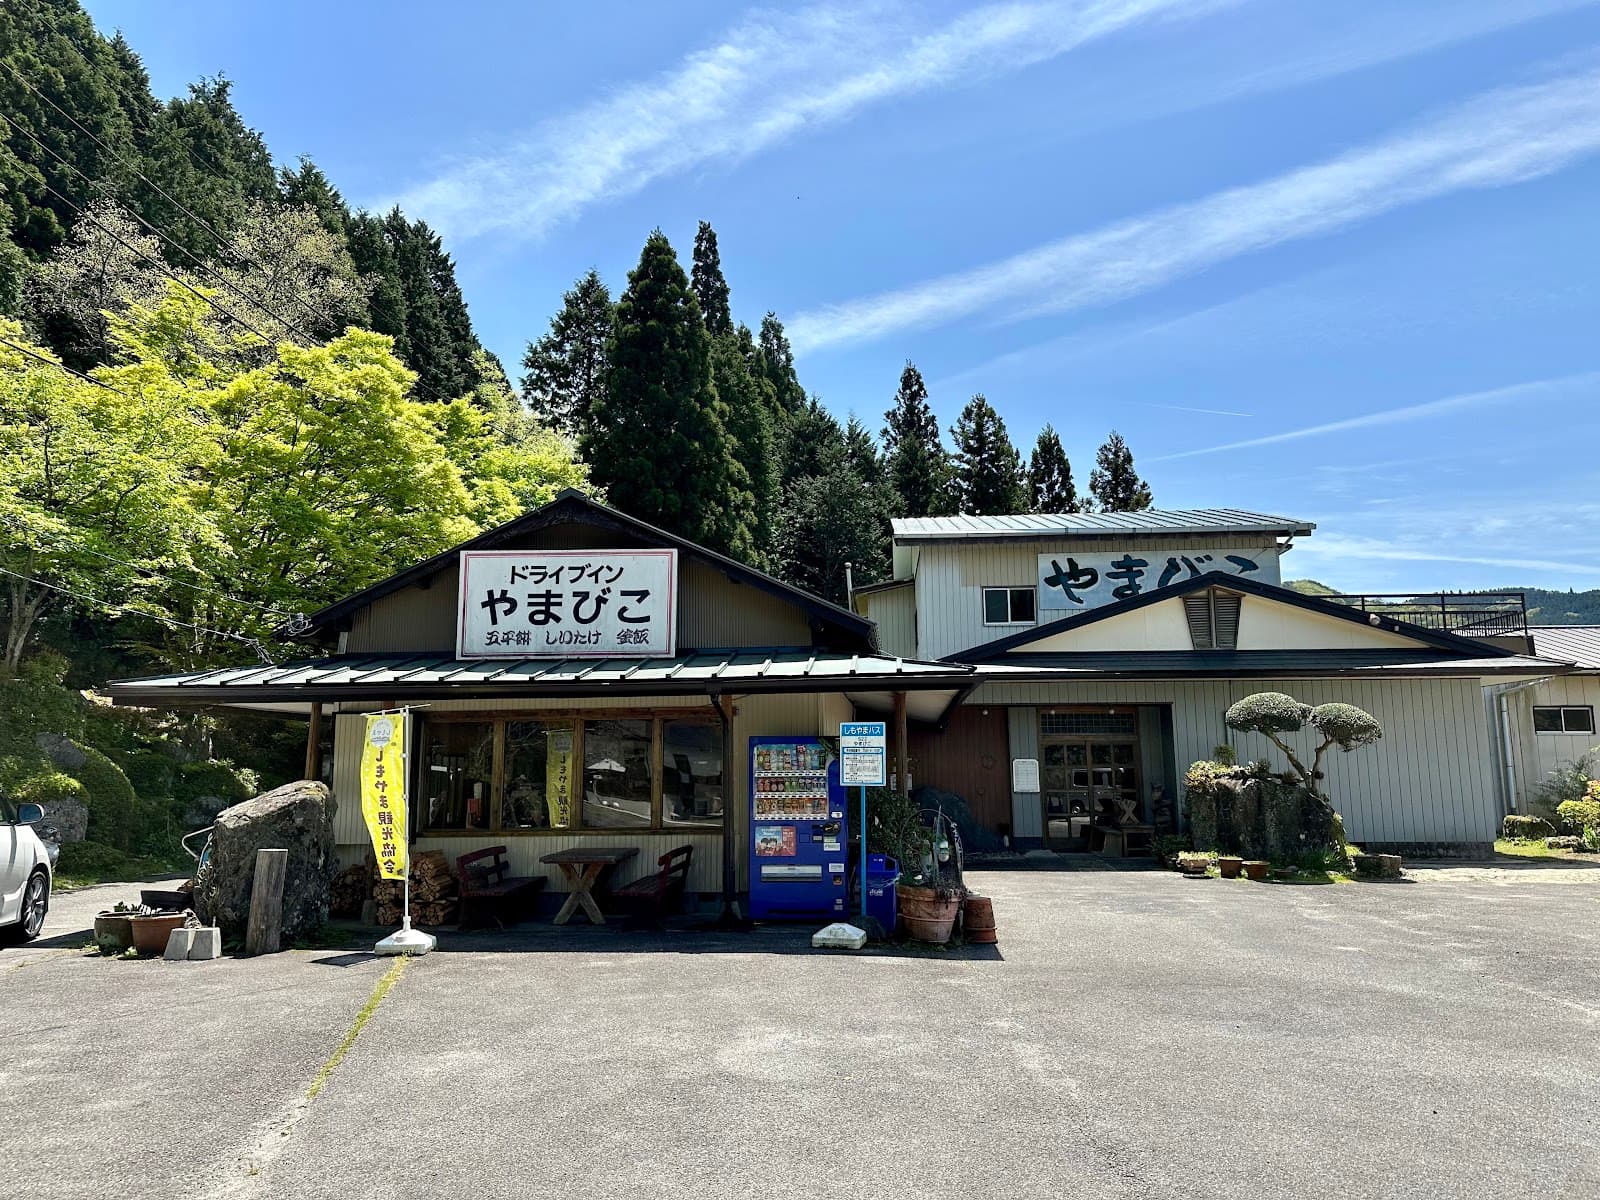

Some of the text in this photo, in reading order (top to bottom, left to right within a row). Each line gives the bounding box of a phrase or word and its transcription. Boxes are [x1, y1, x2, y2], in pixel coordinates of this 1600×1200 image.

[510, 563, 624, 584] ドライブイン
[481, 586, 651, 625] やまびこ
[485, 628, 650, 646] 五平餅 しいたけ 釜飯
[844, 726, 881, 735] しもやまバス
